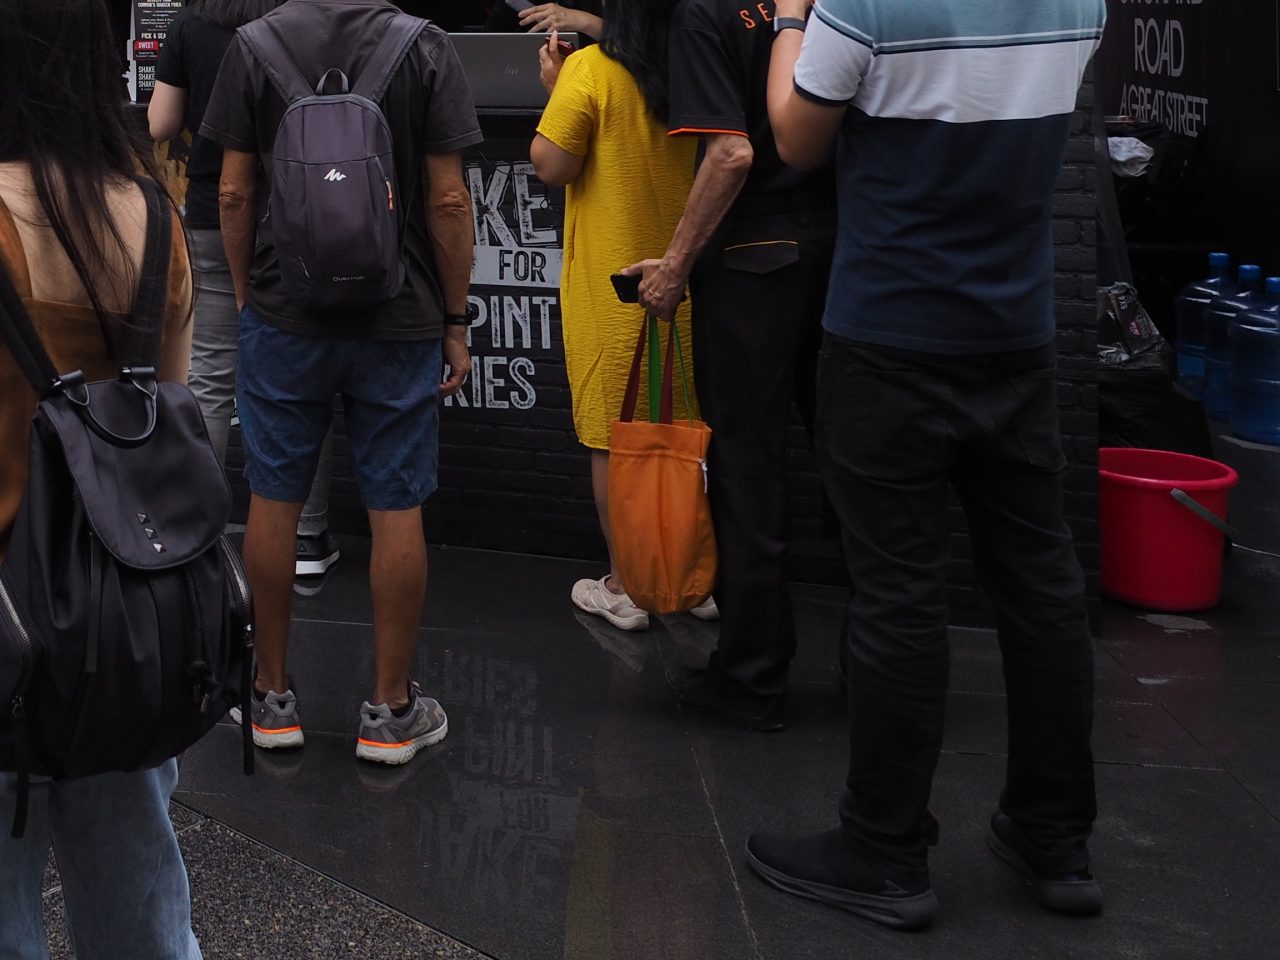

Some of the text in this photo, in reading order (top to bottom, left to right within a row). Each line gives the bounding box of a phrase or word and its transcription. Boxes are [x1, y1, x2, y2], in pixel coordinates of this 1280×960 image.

[1134, 18, 1184, 77] ROAD
[498, 249, 546, 283] FOR
[466, 295, 556, 350] PINT
